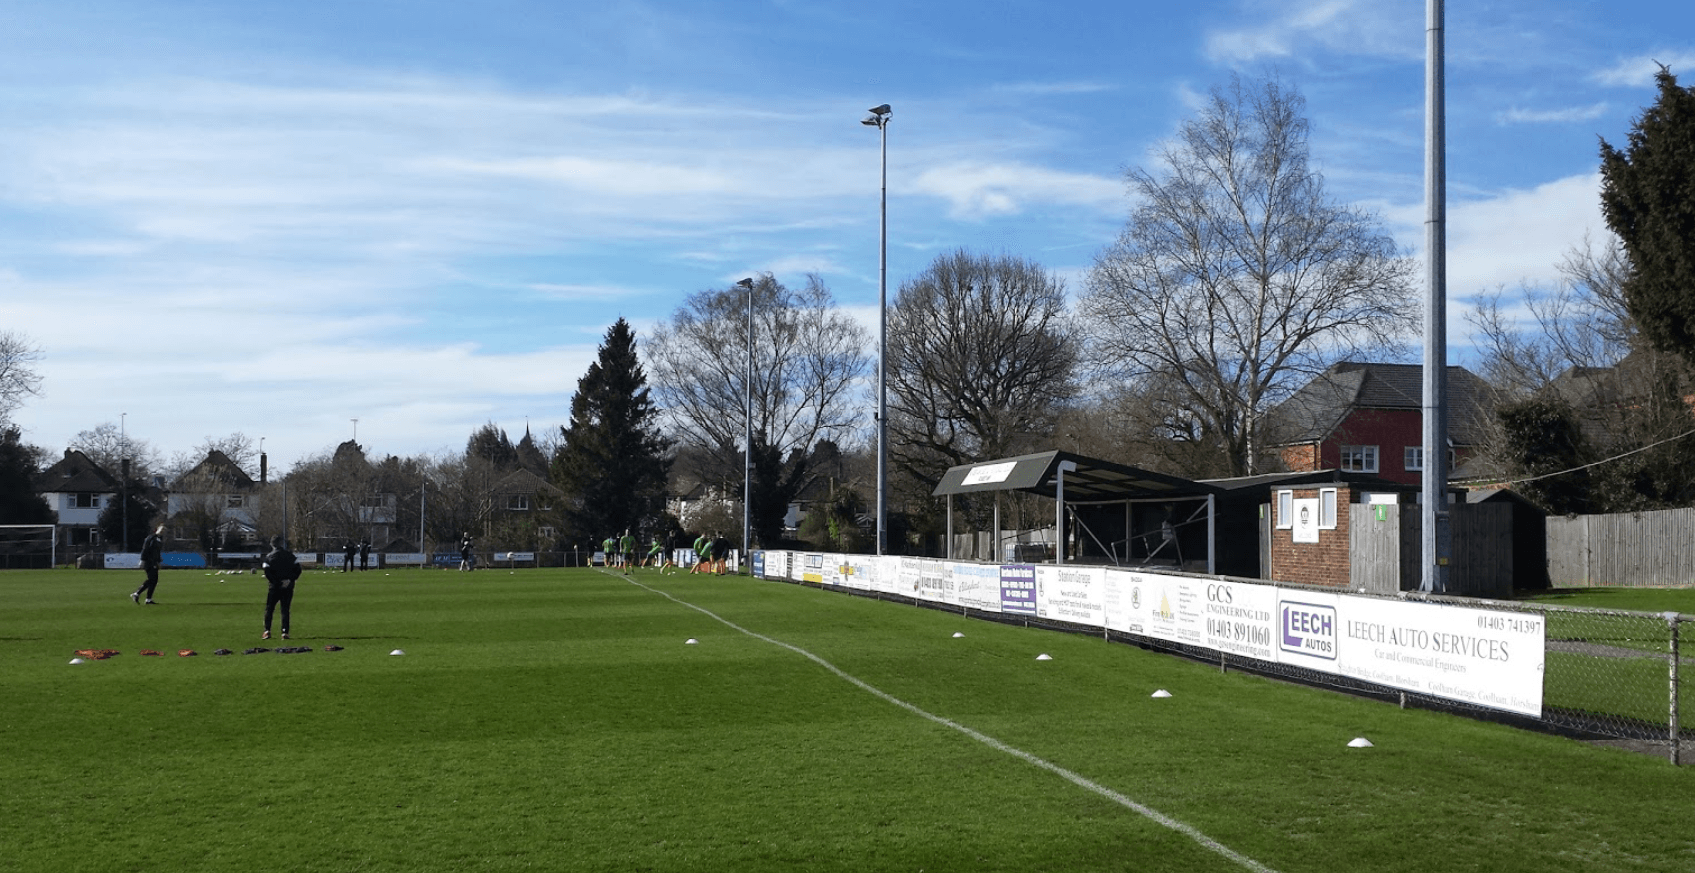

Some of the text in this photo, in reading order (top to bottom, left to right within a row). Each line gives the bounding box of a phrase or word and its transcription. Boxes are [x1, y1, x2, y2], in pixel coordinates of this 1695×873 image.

[1207, 584, 1232, 604] GCS
[1207, 604, 1270, 622] ENGINEERING LTD
[1207, 617, 1231, 639] 01403
[1234, 622, 1270, 647] 891060
[1283, 606, 1332, 648] LEECH
[1477, 616, 1541, 635] 01403 741397
[1305, 639, 1332, 653] AUTOS
[1348, 620, 1509, 662] LEECH AUTO SERVICES
[1374, 648, 1467, 673] Car and Commercial Engineers
[1510, 696, 1540, 712] Horsham
